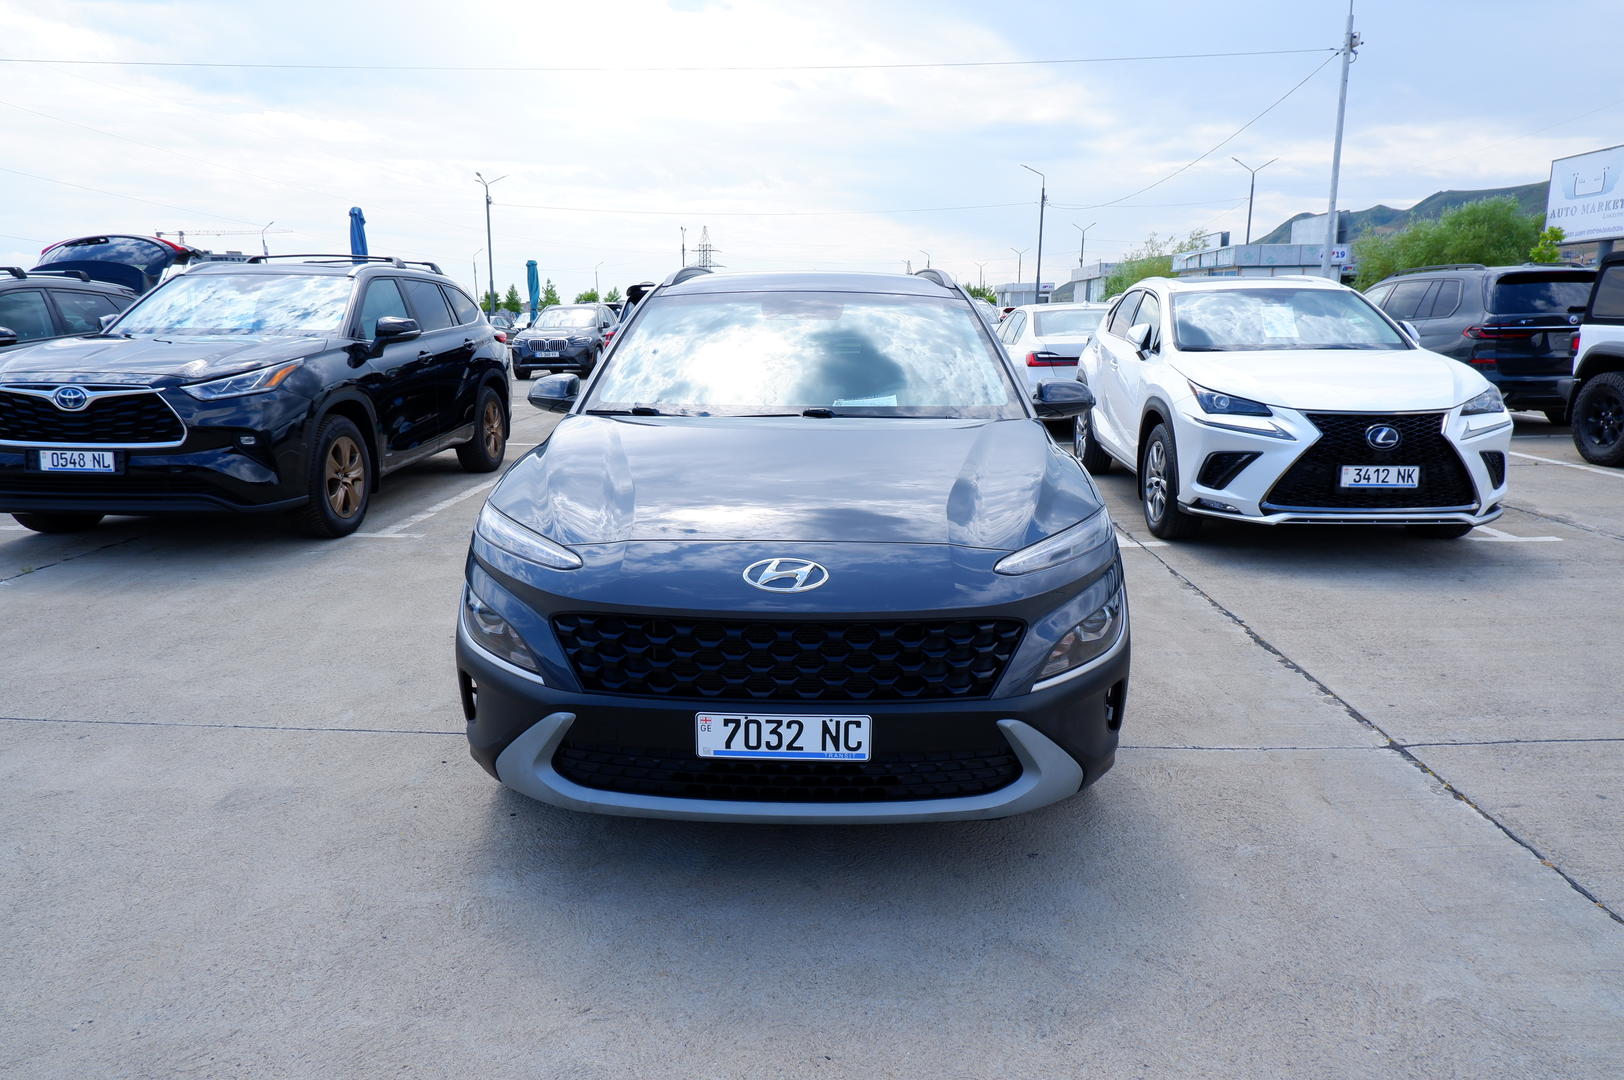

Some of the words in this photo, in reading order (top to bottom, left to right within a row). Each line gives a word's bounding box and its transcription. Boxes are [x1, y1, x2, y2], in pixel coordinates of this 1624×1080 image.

[1550, 205, 1577, 219] AUTO
[51, 452, 86, 468] 0548
[92, 453, 111, 469] NL
[1353, 468, 1390, 484] 3412
[1396, 468, 1416, 484] NK
[700, 724, 712, 732] GE
[723, 718, 804, 751] 7032
[821, 720, 863, 752] NC
